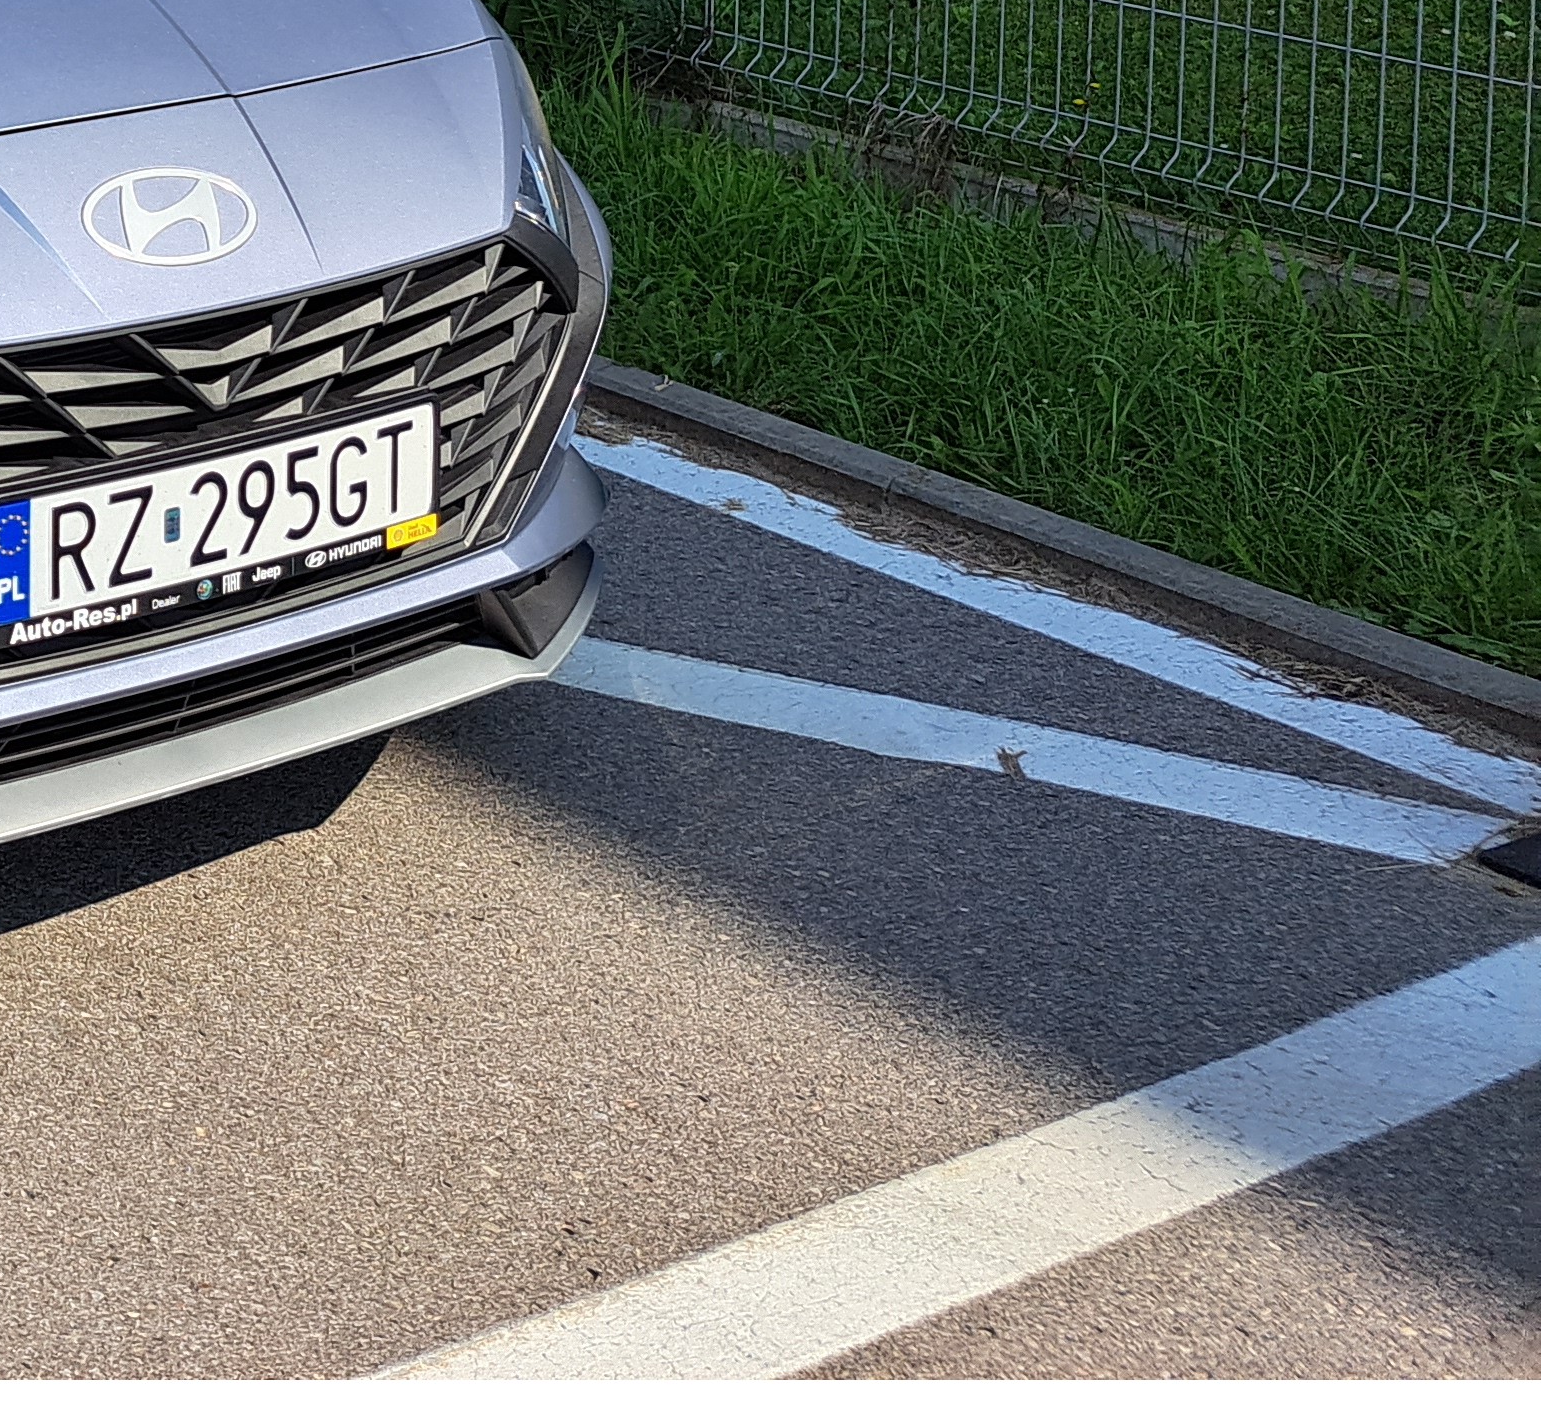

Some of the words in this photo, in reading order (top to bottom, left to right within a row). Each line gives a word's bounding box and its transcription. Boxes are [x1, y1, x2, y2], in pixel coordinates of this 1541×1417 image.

[49, 485, 154, 601] RZ
[189, 419, 414, 568] 295GT
[9, 598, 139, 645] Auto-Res.pl
[151, 594, 182, 611] Dealer
[221, 570, 243, 595] FIAT
[250, 564, 282, 582] Jeep
[328, 533, 383, 562] HYUNDAI
